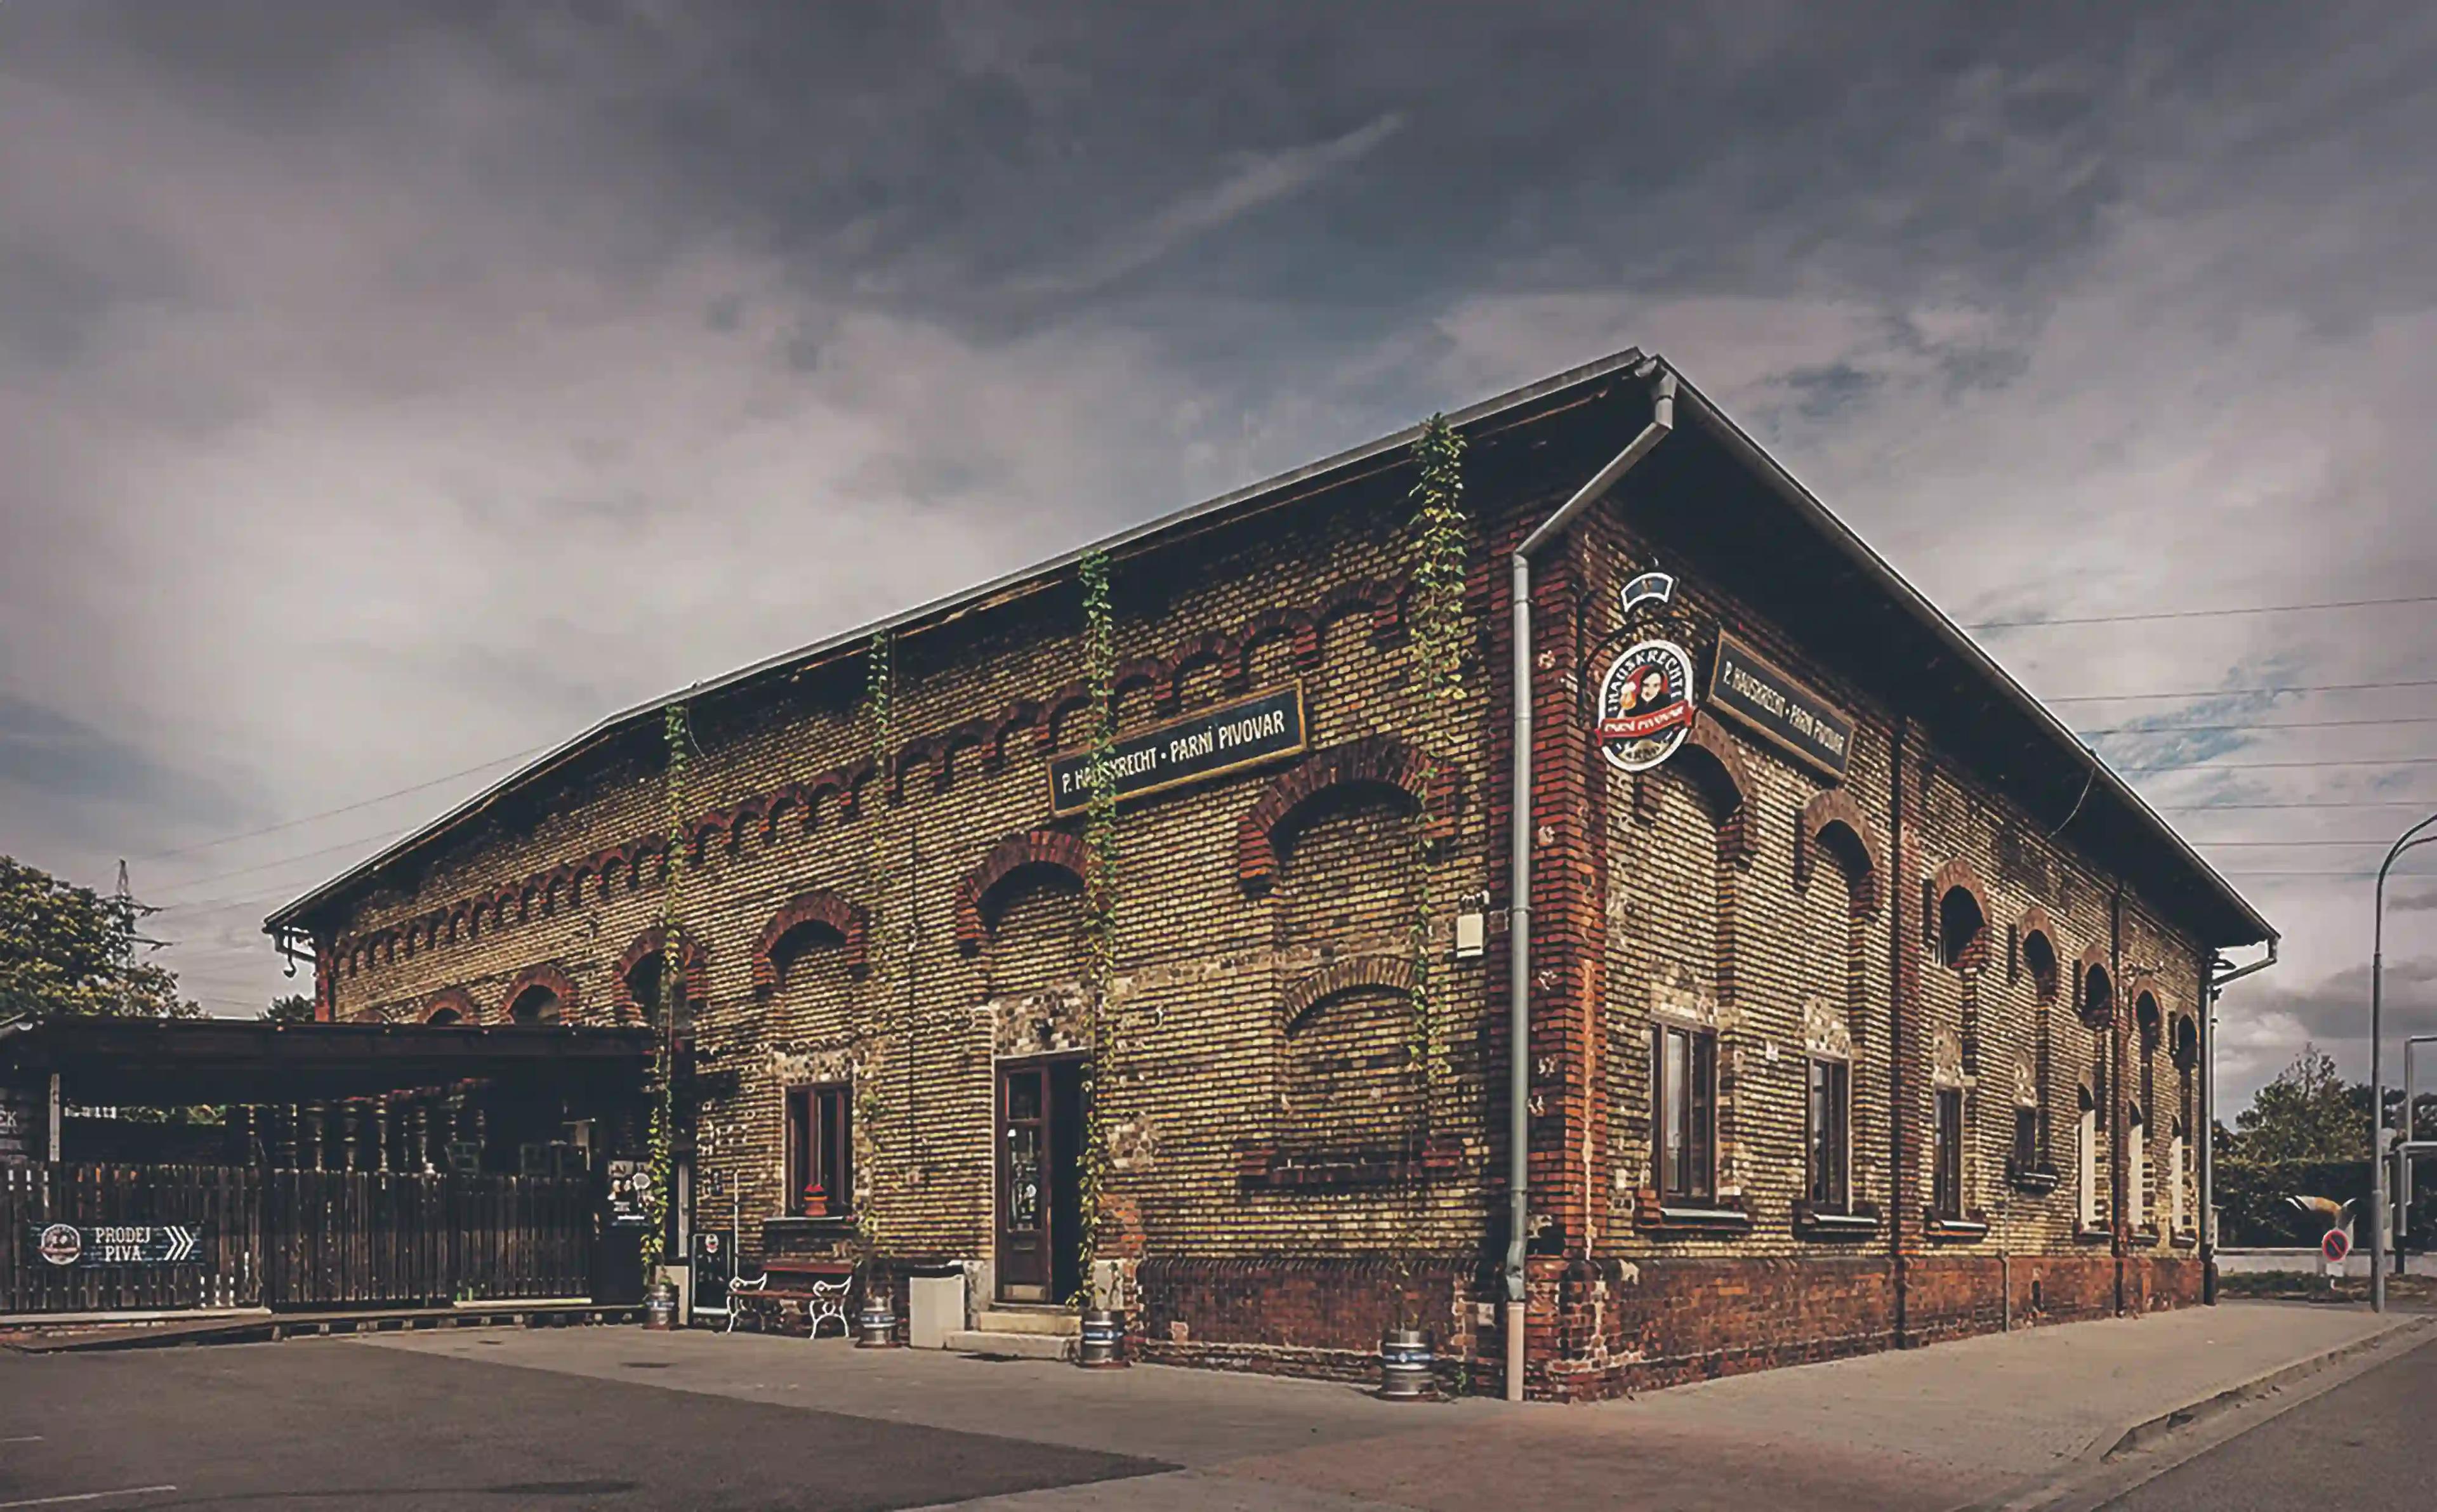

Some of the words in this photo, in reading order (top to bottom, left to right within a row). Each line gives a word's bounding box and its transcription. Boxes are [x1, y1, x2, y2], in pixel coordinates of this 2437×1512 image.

[1170, 726, 1213, 763] PARNÍ
[1218, 710, 1285, 749] PIVOVAR
[95, 1226, 151, 1244] PRODEJ
[105, 1245, 142, 1262] PIVA
